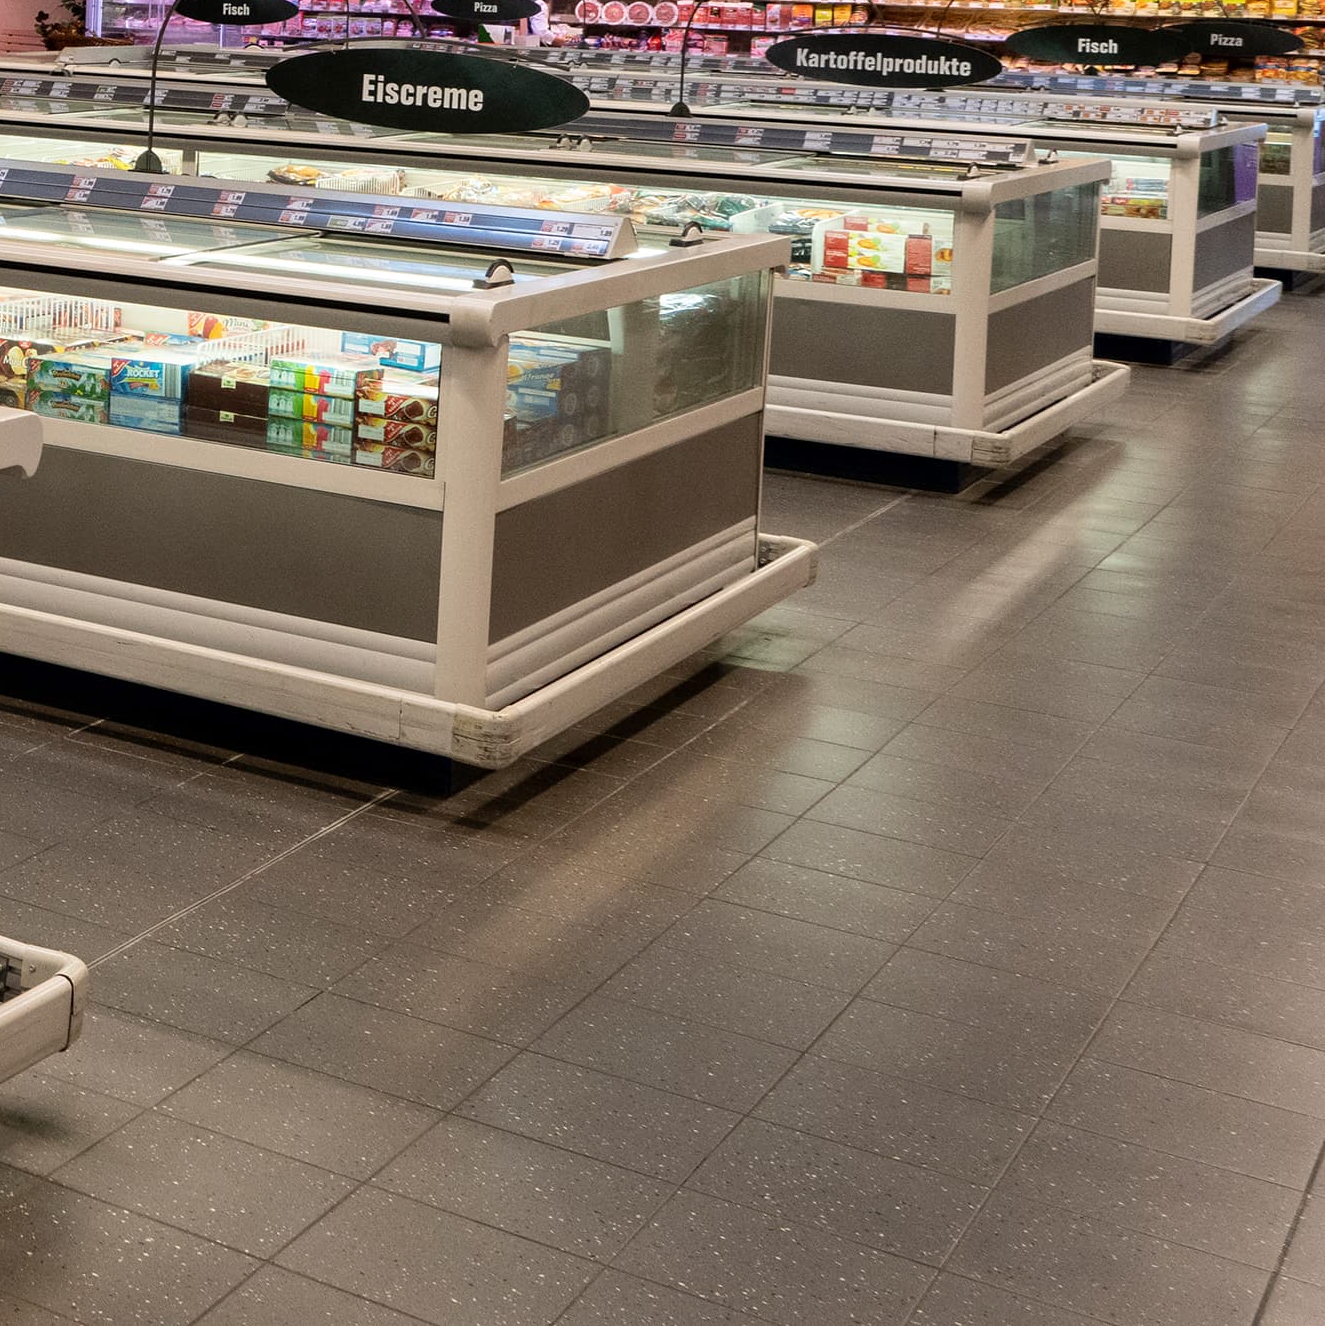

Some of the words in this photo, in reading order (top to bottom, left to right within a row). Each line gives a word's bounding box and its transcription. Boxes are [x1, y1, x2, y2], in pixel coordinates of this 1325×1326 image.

[222, 2, 250, 17] Fisch
[474, 2, 498, 14] Pizza
[1077, 38, 1118, 55] Fisch
[1210, 33, 1244, 47] Pizza
[796, 48, 972, 77] Kartoffelprodukte
[361, 74, 484, 112] Eiscreme
[126, 368, 160, 379] ROCKET
